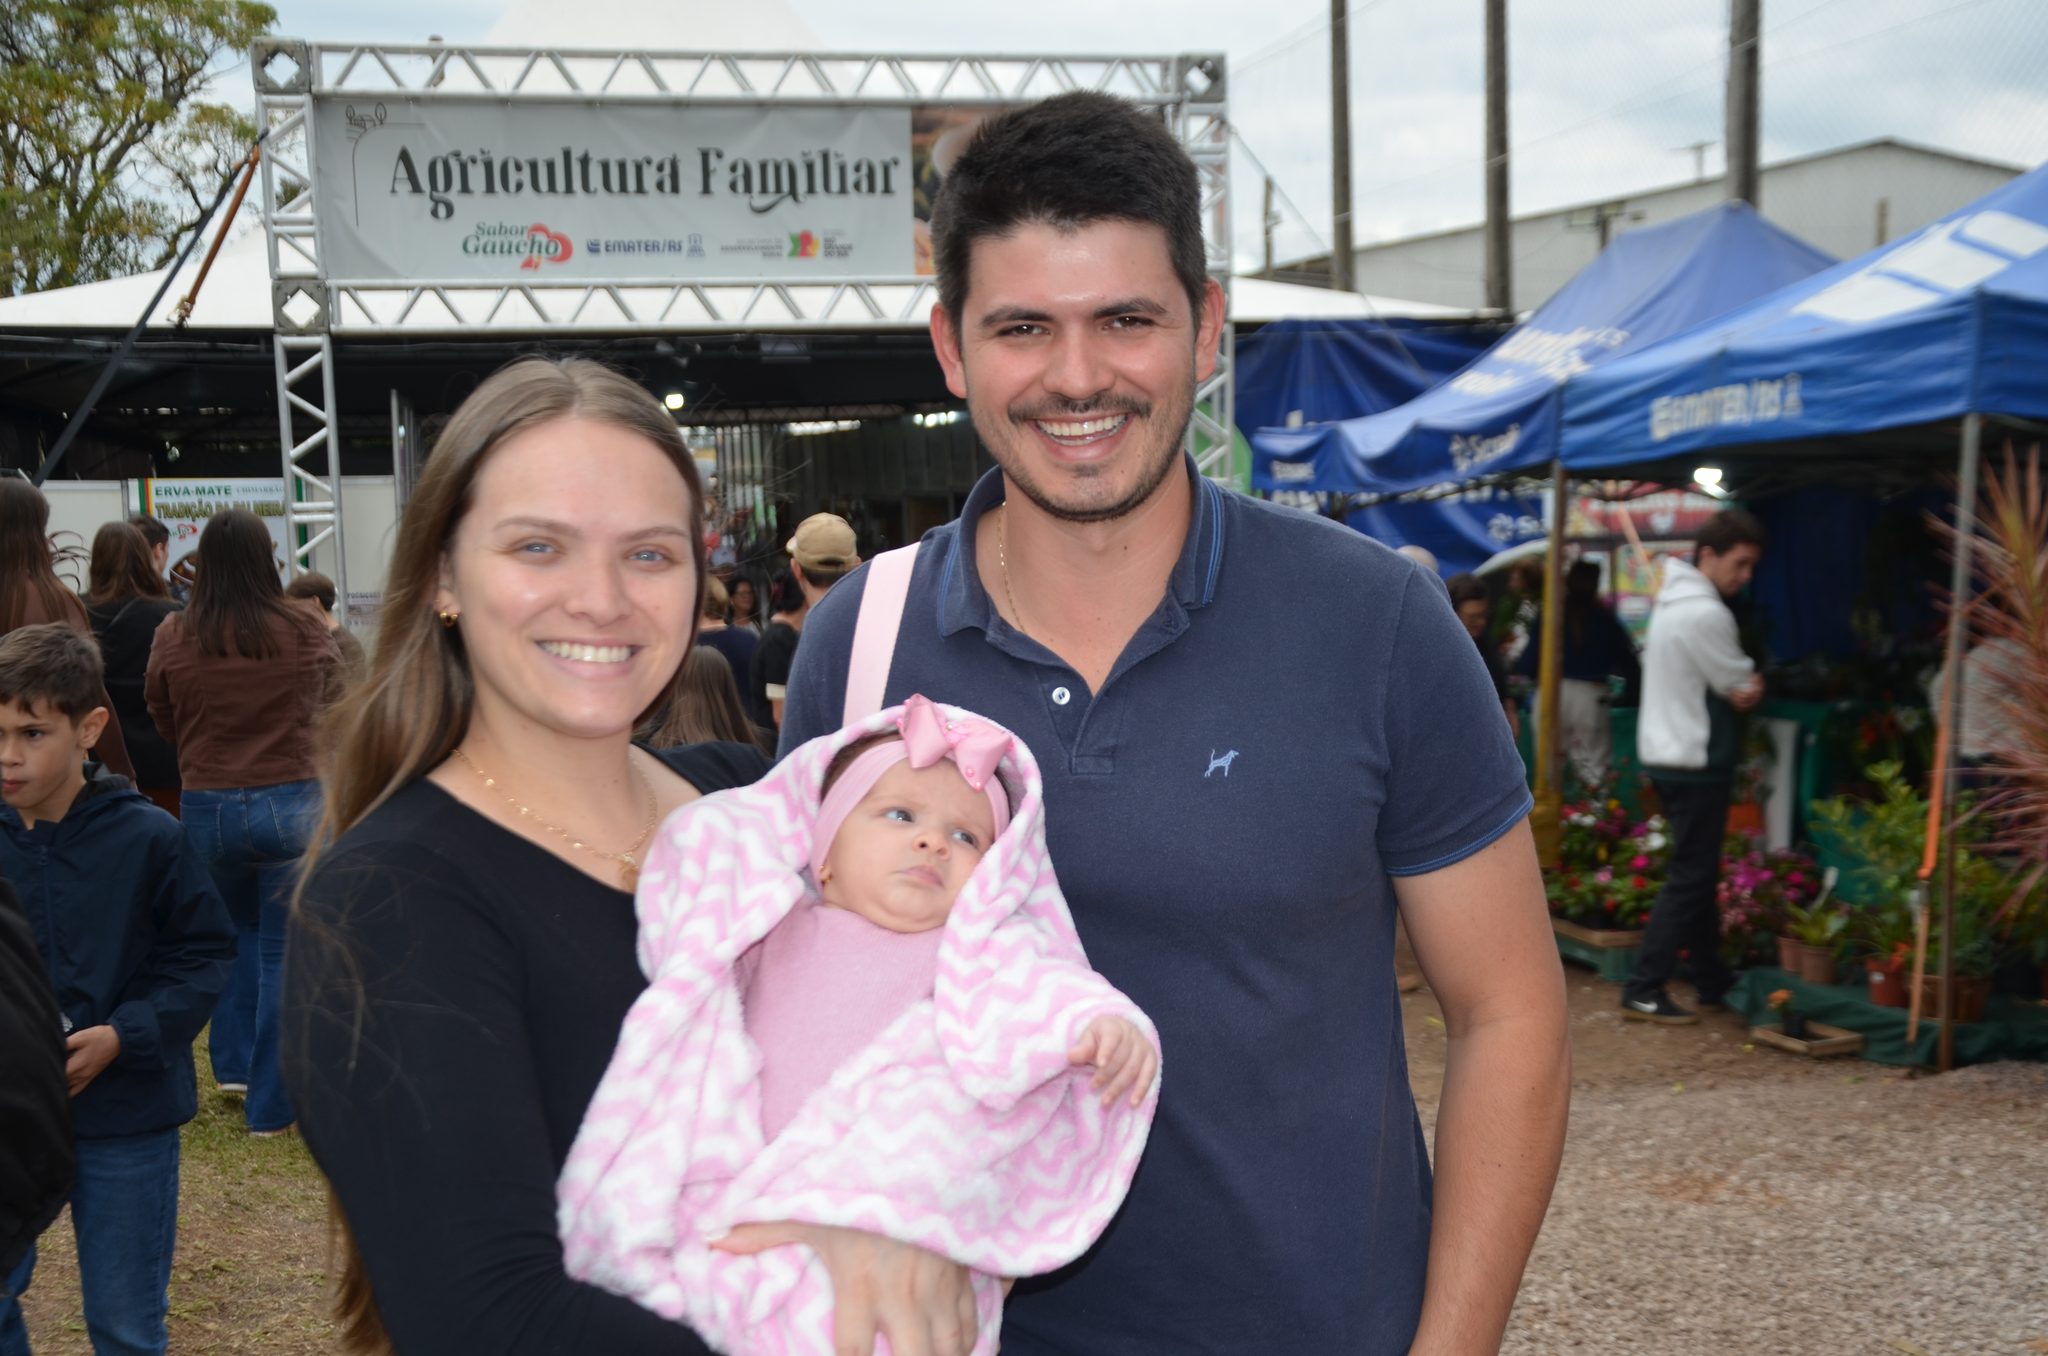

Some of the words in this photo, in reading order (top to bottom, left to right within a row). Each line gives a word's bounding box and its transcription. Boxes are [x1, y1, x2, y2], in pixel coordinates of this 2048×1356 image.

[390, 145, 681, 219] Agricultura
[697, 147, 900, 213] Familiar
[475, 222, 529, 237] Sabor
[604, 239, 683, 253] EMATER/RS
[154, 485, 232, 496] ERVA-MATE
[155, 500, 212, 521] TRADIÇÃO
